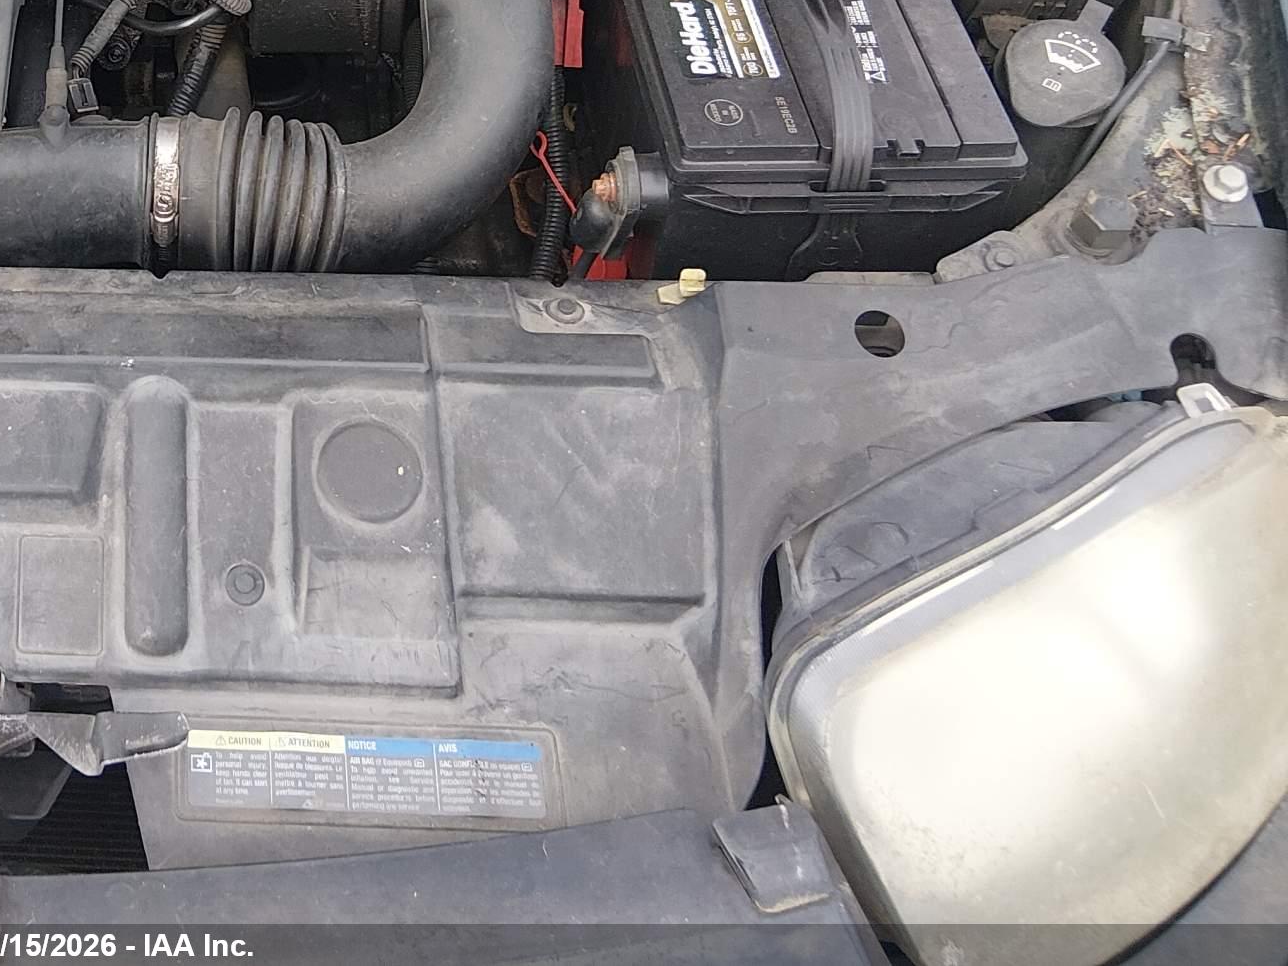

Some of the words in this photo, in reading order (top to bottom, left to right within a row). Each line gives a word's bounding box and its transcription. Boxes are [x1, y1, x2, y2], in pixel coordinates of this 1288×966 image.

[670, 1, 718, 74] DieHard
[228, 737, 261, 746] CAUTION
[287, 738, 330, 748] ATTENTION
[348, 740, 376, 750] NOTICE
[438, 743, 457, 753] AVIS
